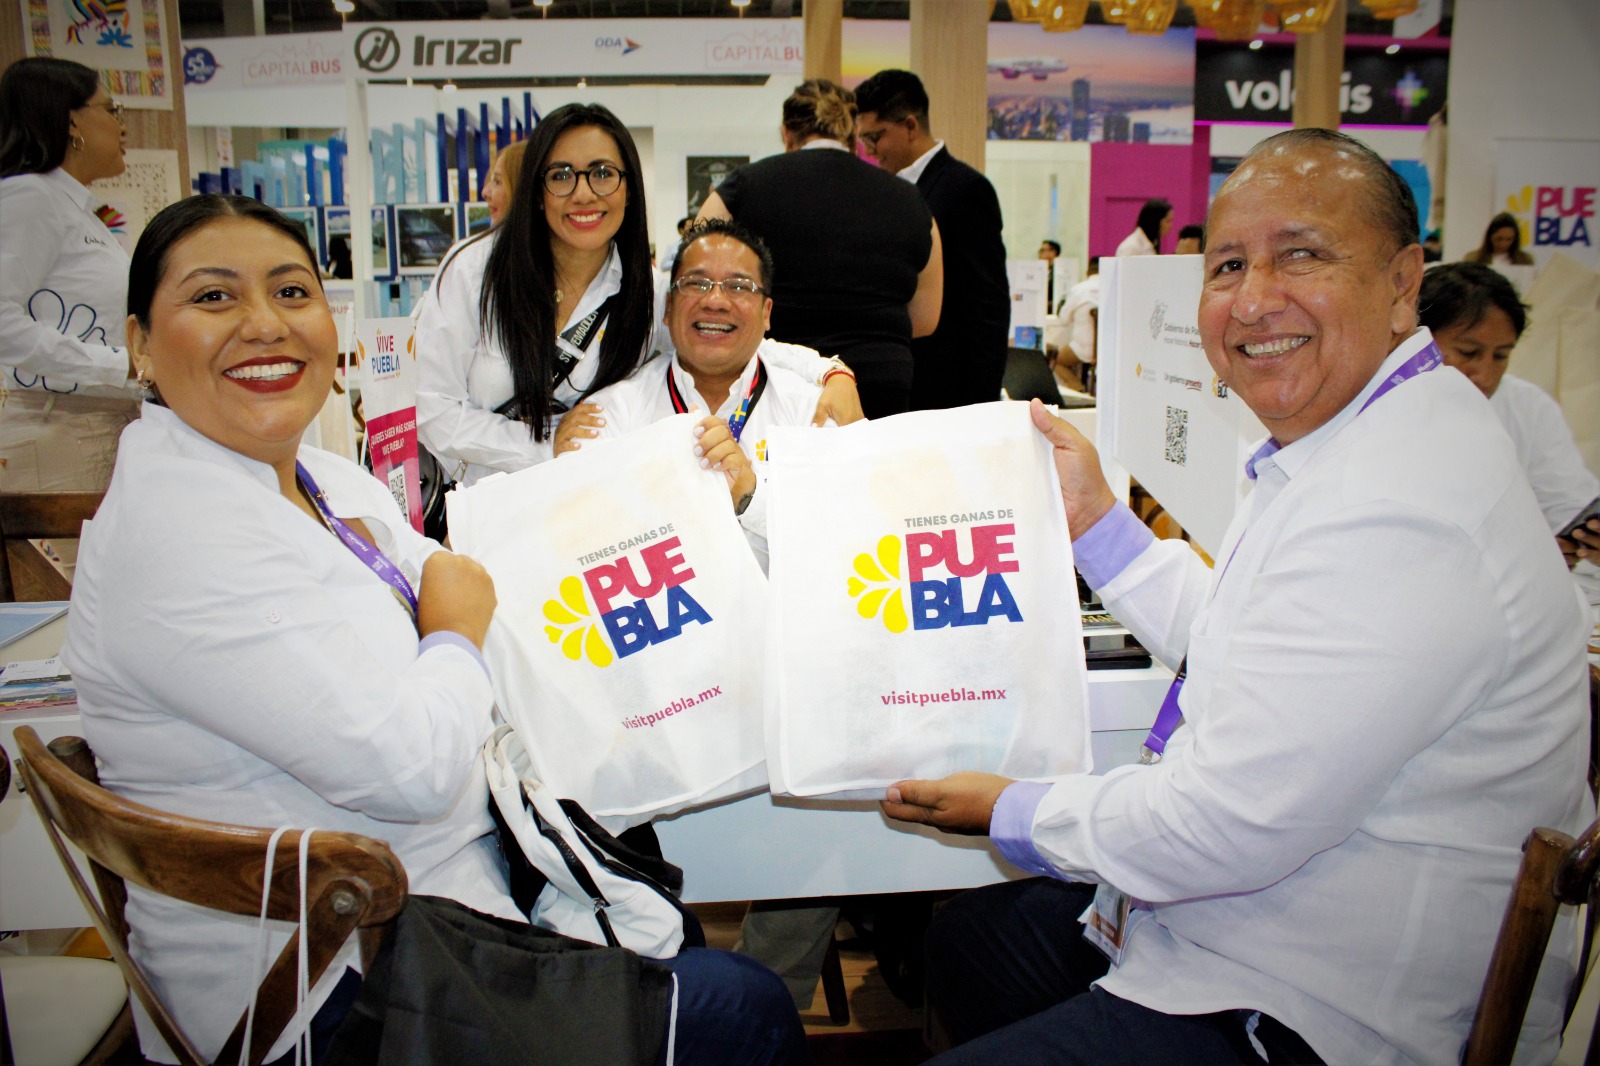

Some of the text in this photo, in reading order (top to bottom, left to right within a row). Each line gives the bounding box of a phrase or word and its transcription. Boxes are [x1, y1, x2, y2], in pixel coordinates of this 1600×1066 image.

[413, 35, 523, 66] Irizar
[594, 36, 622, 48] ODA
[712, 44, 804, 62] CAPITALBU
[248, 58, 342, 79] CAPITALBUS
[1225, 69, 1373, 114] volis
[1535, 186, 1598, 218] PUE
[1534, 216, 1592, 247] BLA
[376, 334, 395, 354] VIVE
[371, 354, 401, 375] PUEBLA
[384, 426, 396, 440] SABER
[395, 422, 404, 436] MÁS
[403, 419, 416, 432] SOBRE
[381, 444, 390, 456] VIVE
[904, 508, 1014, 529] TIENES GANAS DE
[577, 523, 675, 567] TIENES GANAS DE
[905, 523, 1020, 583] PUE
[583, 535, 696, 616] PUE
[910, 573, 1024, 631] BLA
[601, 584, 714, 660] BLA
[621, 685, 723, 730] visitpuebla.mx
[880, 687, 1007, 707] visitpuebla.mx
